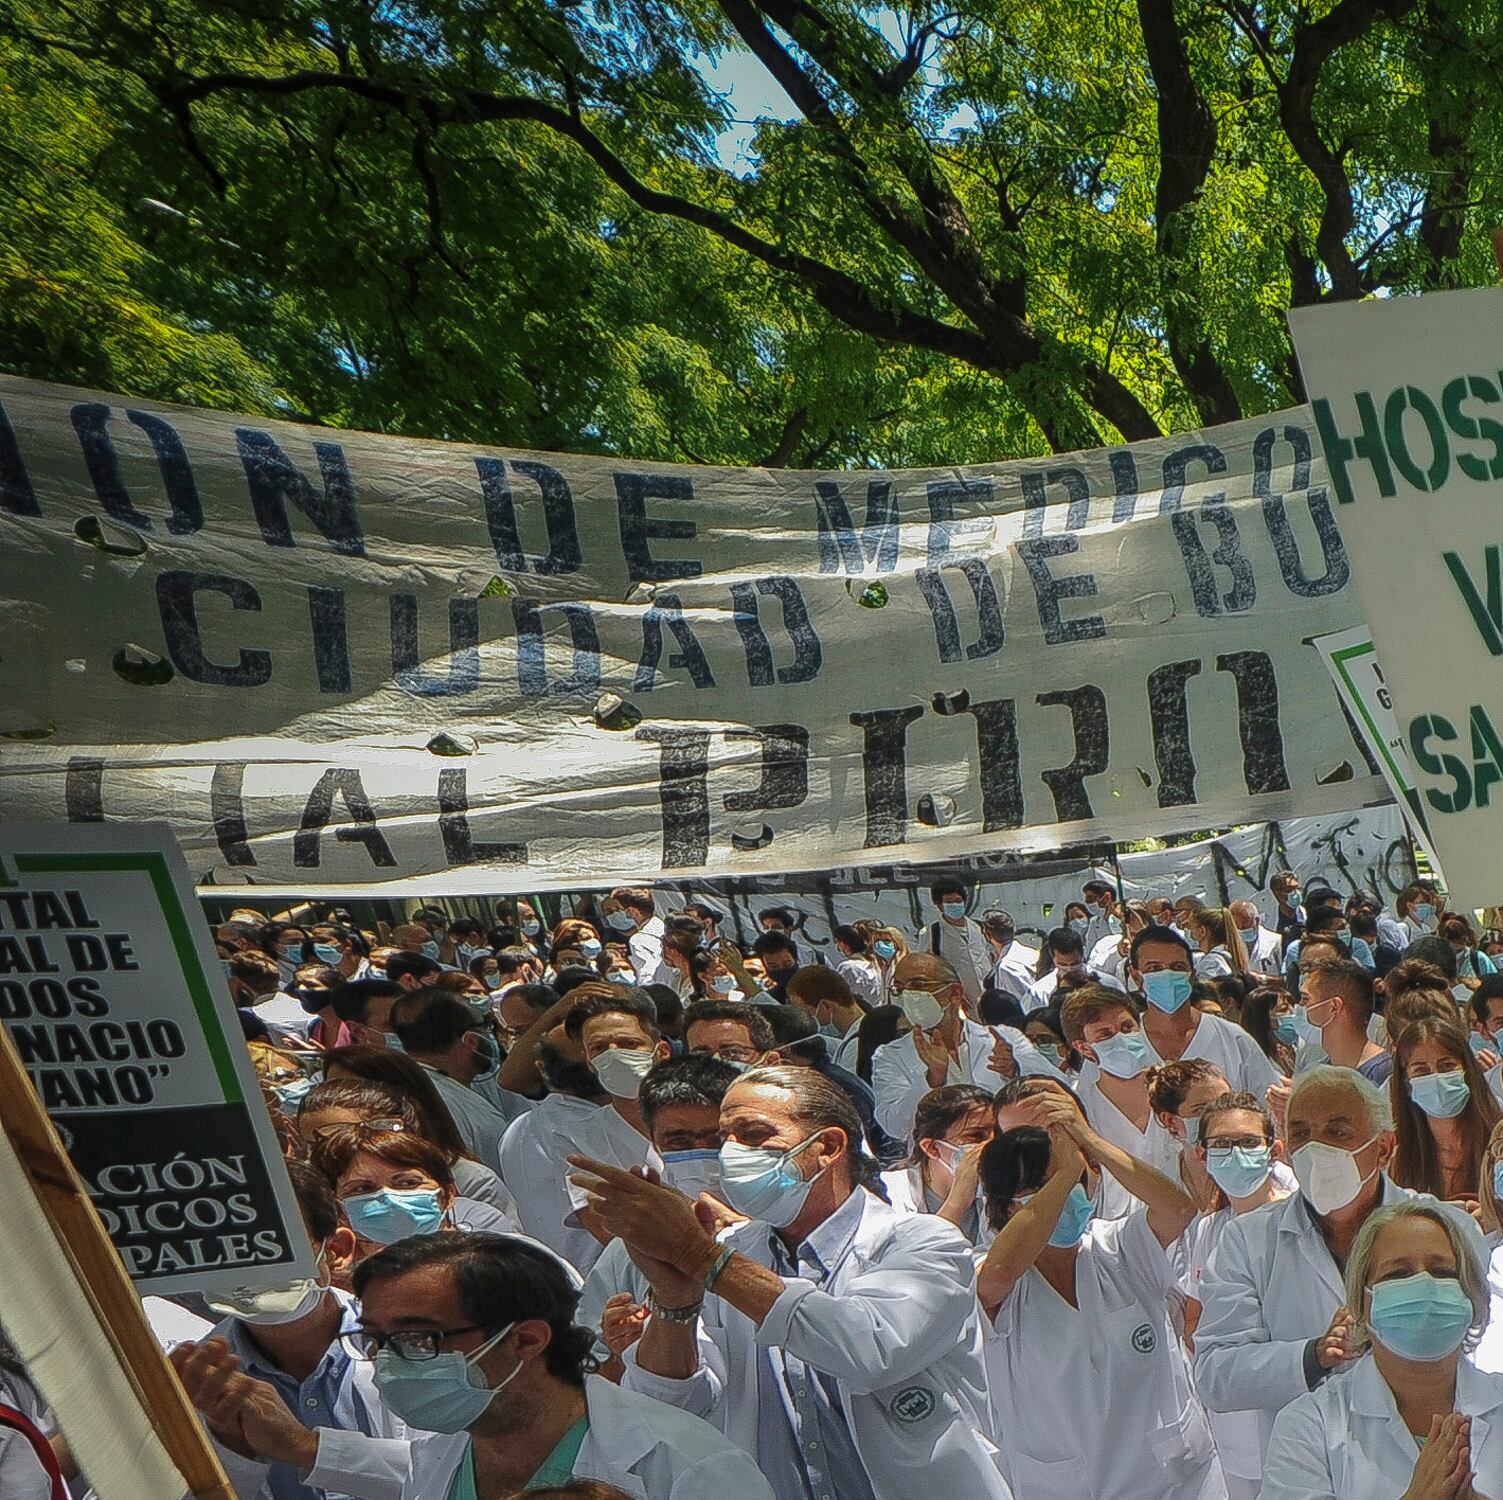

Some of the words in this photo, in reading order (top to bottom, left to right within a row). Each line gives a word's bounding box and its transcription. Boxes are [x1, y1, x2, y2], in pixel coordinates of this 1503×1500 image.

[474, 456, 702, 580] DE
[155, 569, 823, 696] CIUDAD
[915, 537, 1108, 664] DE
[65, 931, 141, 972] DE
[10, 1018, 187, 1063] NACIO
